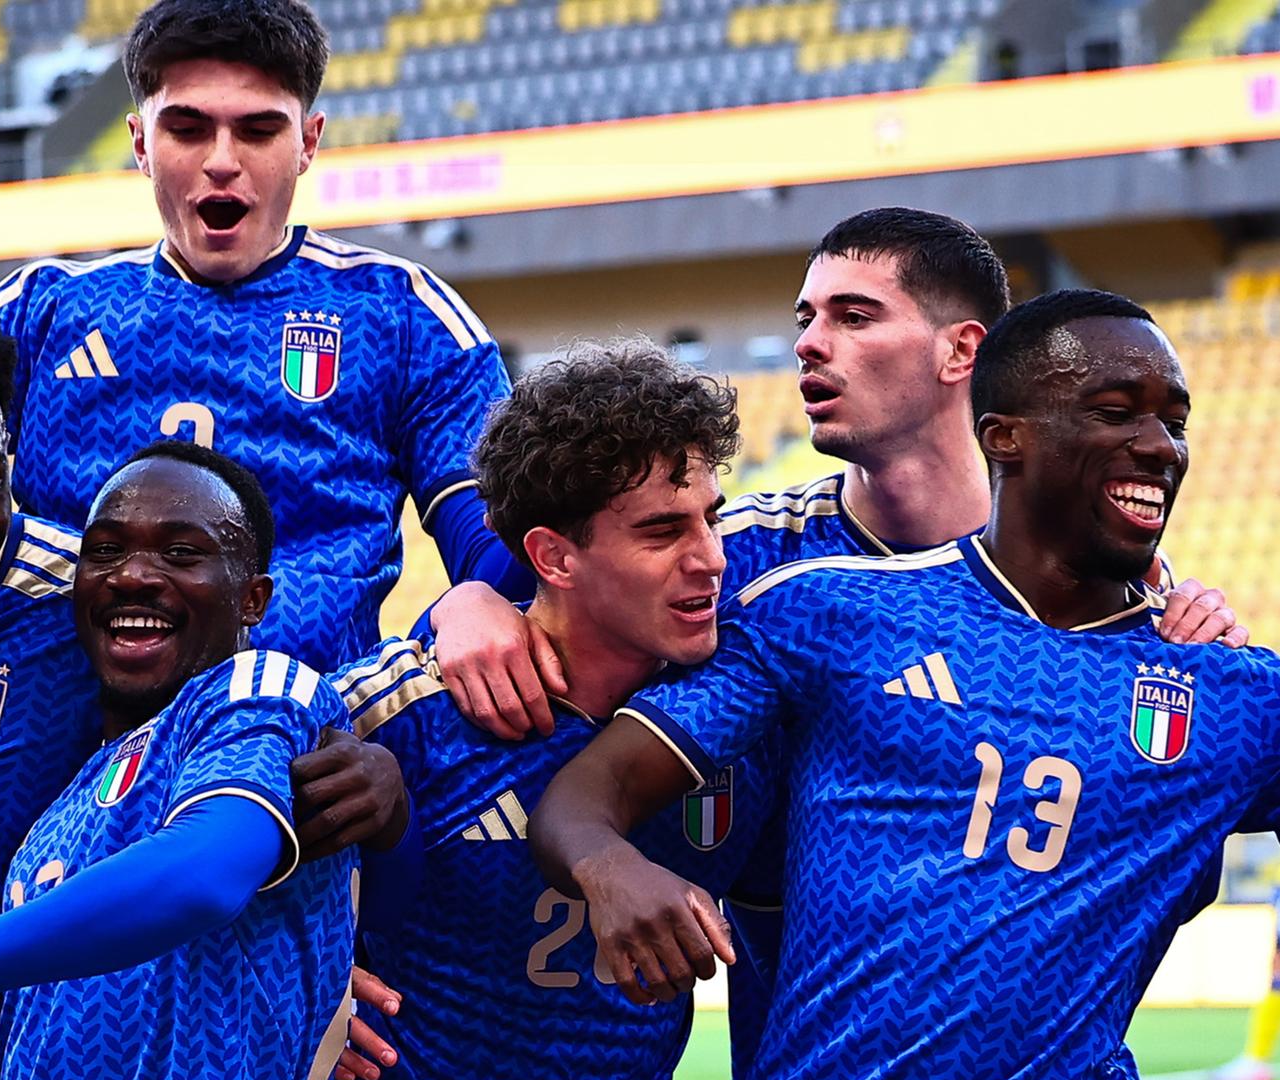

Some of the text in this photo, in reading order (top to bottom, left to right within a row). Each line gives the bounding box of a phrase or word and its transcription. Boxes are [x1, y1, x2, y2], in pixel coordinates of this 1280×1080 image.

[287, 329, 335, 348] ITALIA
[1139, 685, 1187, 708] ITALIA
[963, 741, 1082, 872] 13
